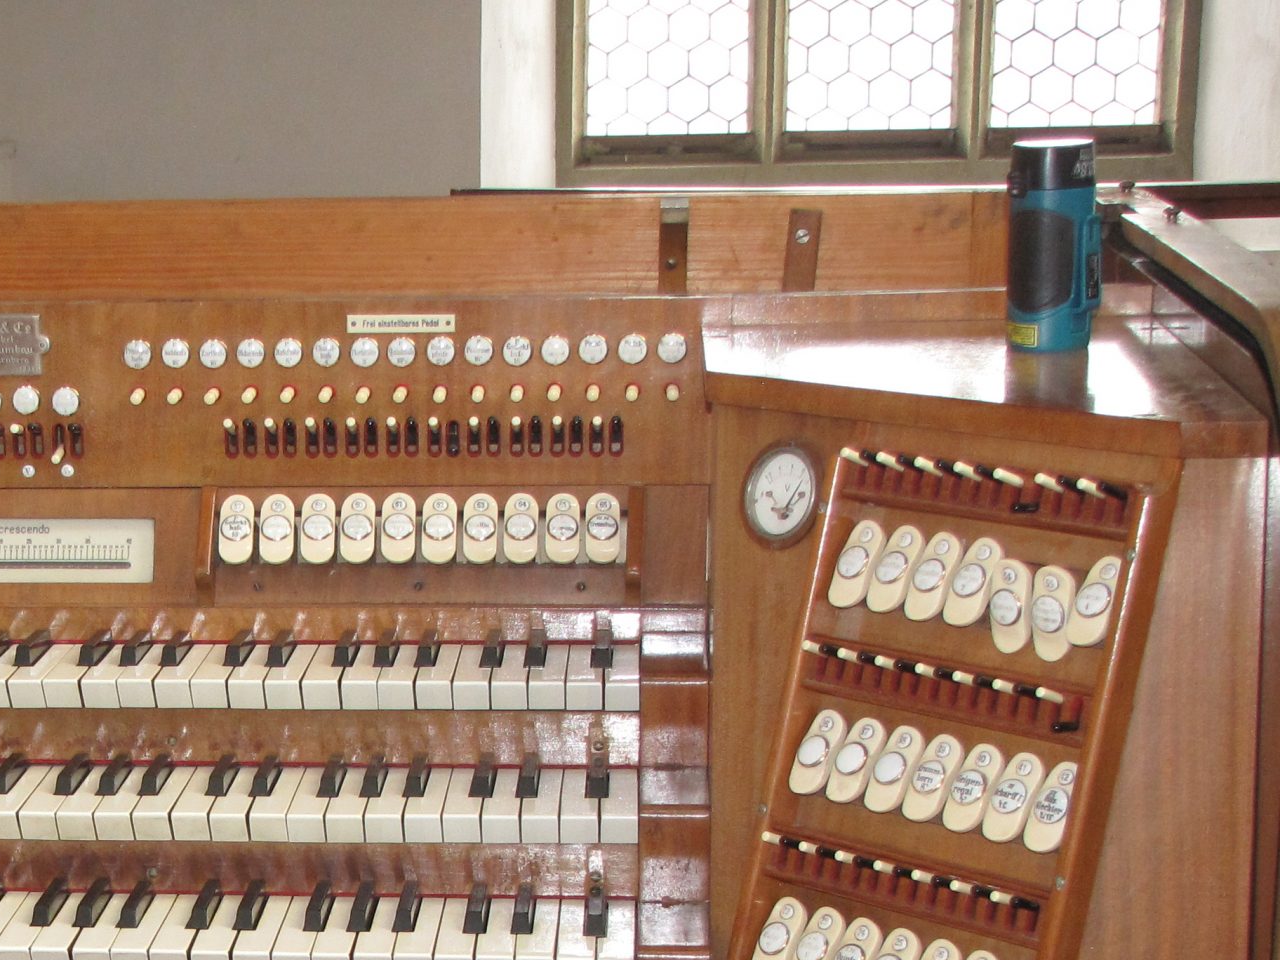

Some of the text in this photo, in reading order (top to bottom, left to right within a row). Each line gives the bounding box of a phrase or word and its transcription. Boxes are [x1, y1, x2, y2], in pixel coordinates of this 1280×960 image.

[0, 323, 10, 333] &
[362, 319, 440, 328] Frei einstellbares Pedal
[953, 786, 973, 797] regal
